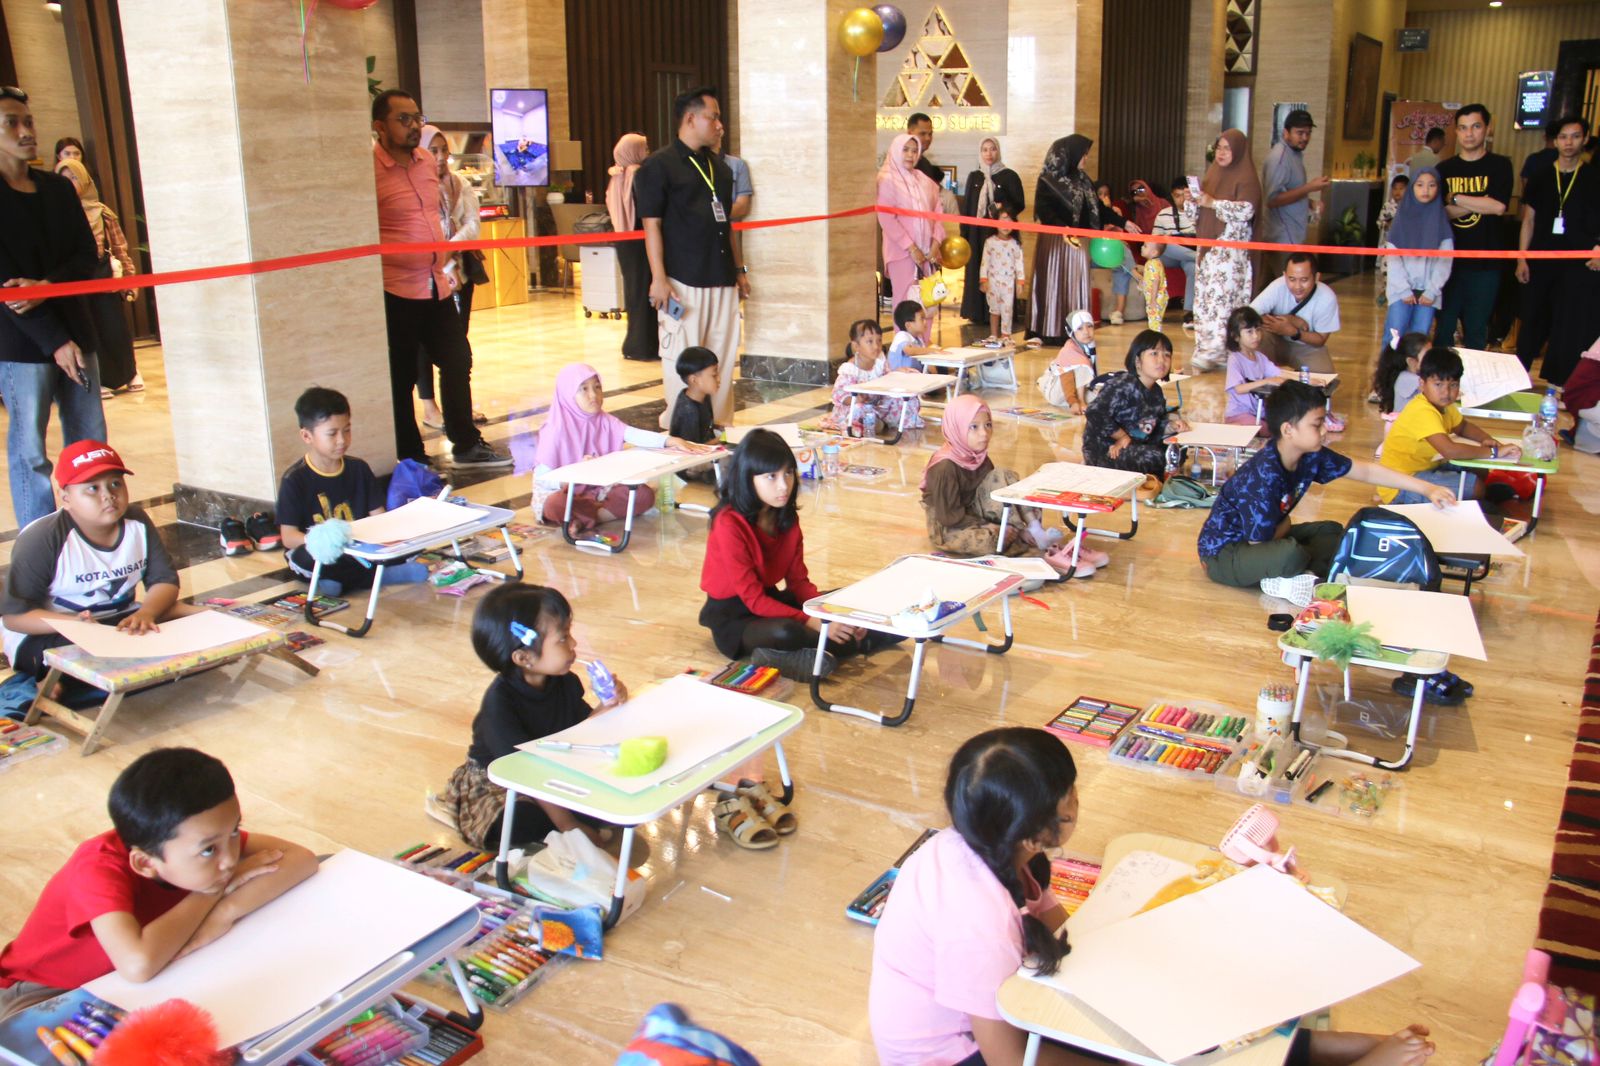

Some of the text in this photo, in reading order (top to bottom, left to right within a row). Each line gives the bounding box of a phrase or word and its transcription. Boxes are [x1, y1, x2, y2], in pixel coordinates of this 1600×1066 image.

[949, 114, 999, 131] SUITES
[1446, 176, 1489, 193] NIRVANA
[75, 558, 148, 583] KOTA WISATA
